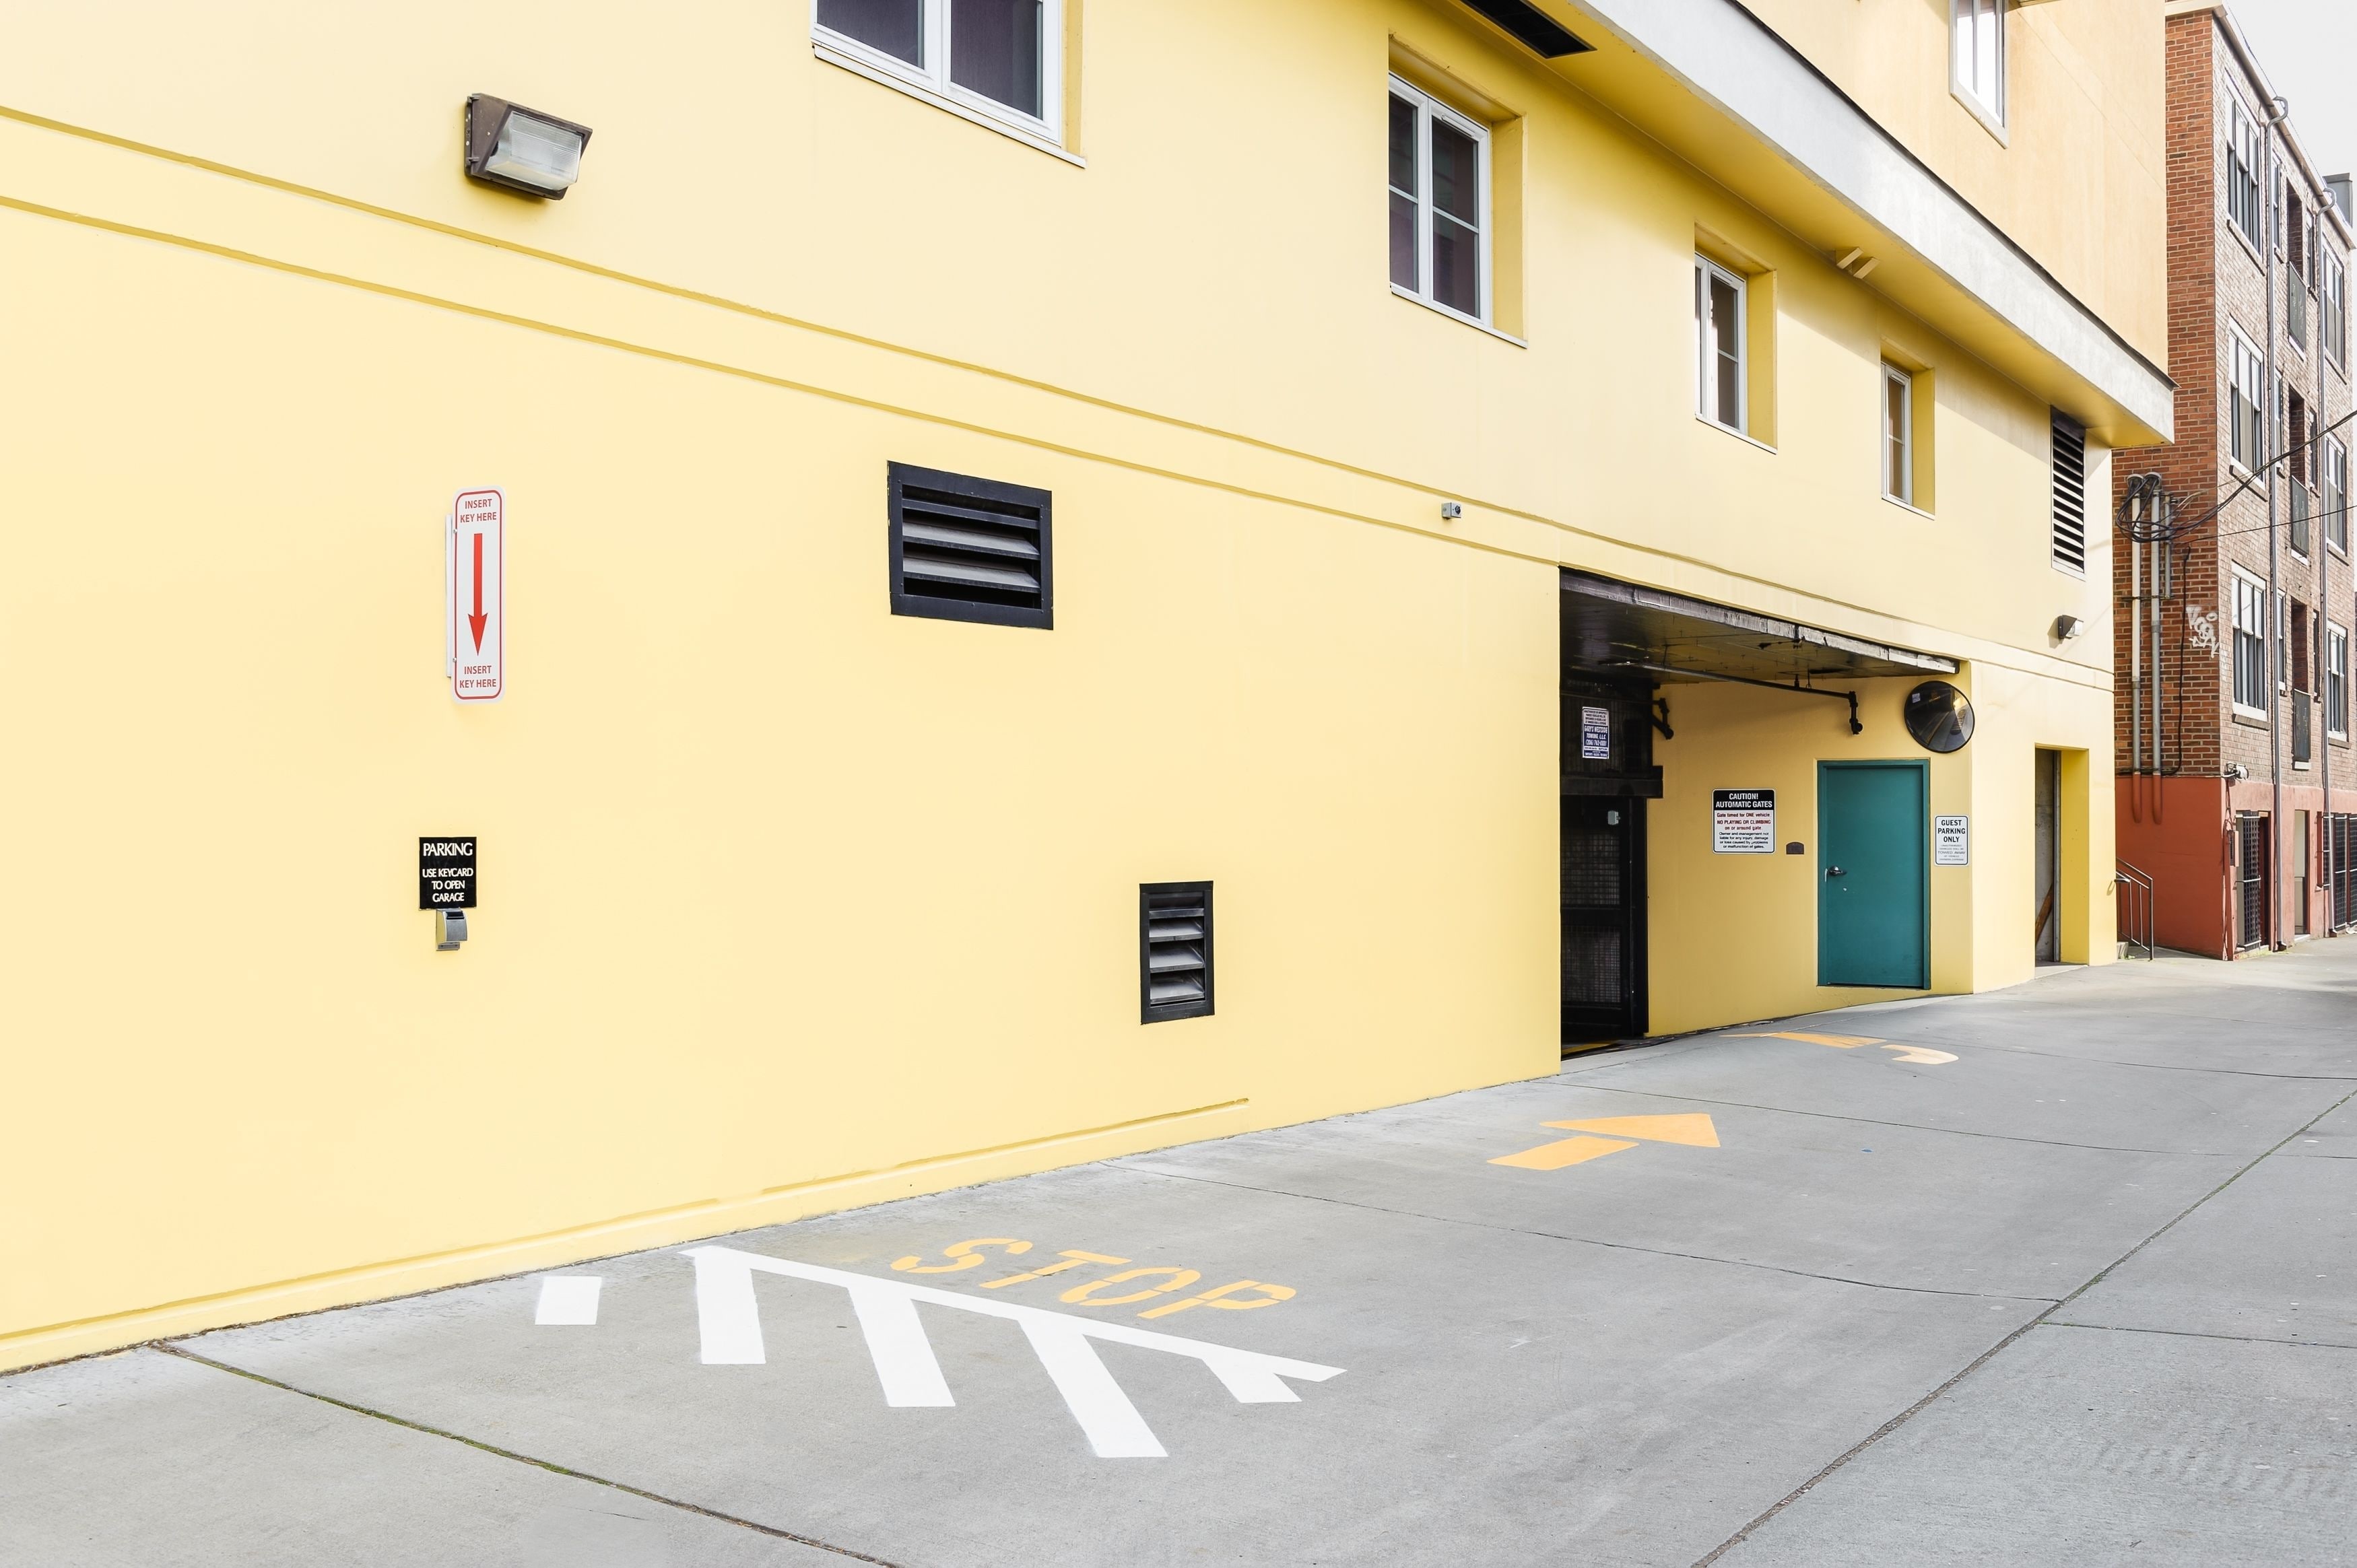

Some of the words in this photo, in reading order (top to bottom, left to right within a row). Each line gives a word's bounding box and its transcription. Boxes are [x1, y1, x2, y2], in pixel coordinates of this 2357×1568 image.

[465, 499, 492, 509] INSERT
[460, 514, 475, 523] KEY
[477, 512, 497, 521] HERE
[464, 665, 492, 675] INSERT
[459, 679, 474, 688] KEY
[476, 679, 496, 687] HERE
[423, 843, 473, 856] PARKING
[422, 868, 436, 878] USE
[438, 868, 473, 877] KEYCARD
[432, 881, 443, 889] TO
[444, 880, 465, 889] OPEN
[432, 893, 464, 902] GARAGE
[890, 1238, 1296, 1319] STOP
